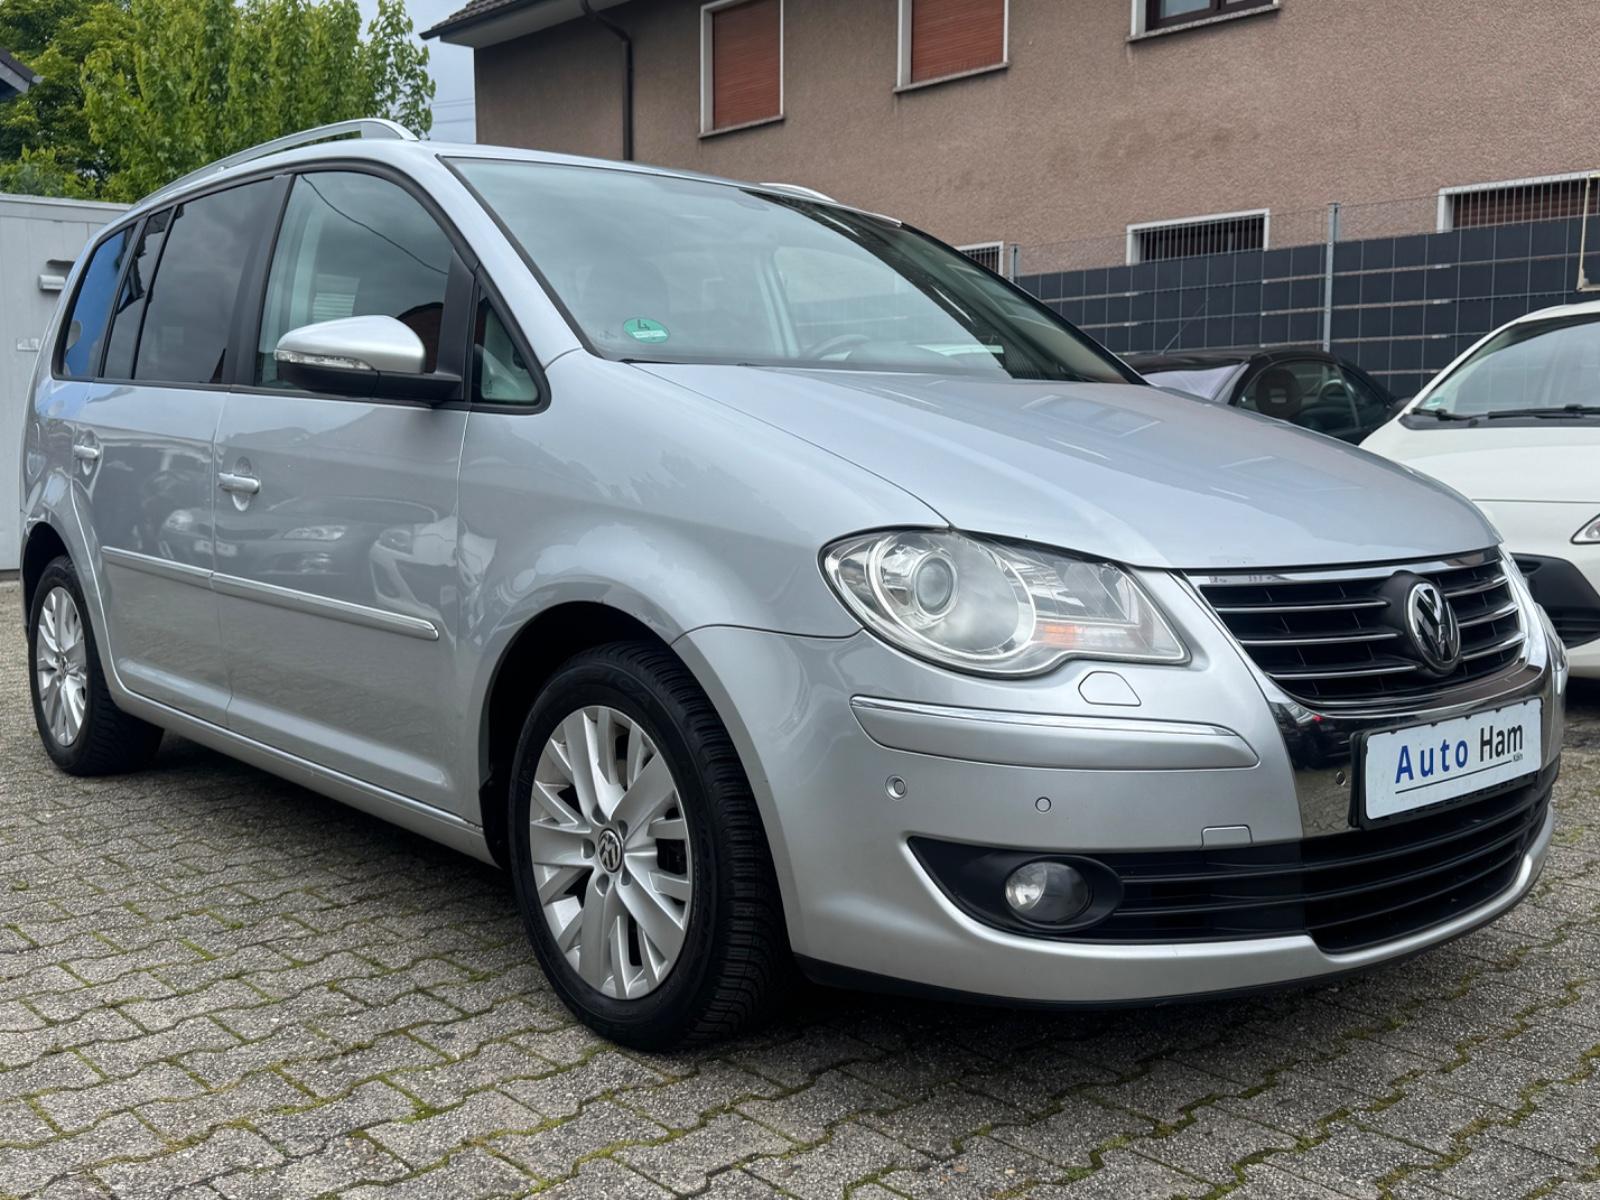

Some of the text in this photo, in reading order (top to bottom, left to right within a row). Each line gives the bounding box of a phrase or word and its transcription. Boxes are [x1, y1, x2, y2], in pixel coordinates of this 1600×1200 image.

[637, 319, 650, 330] 4
[1395, 724, 1523, 784] Auto Ham
